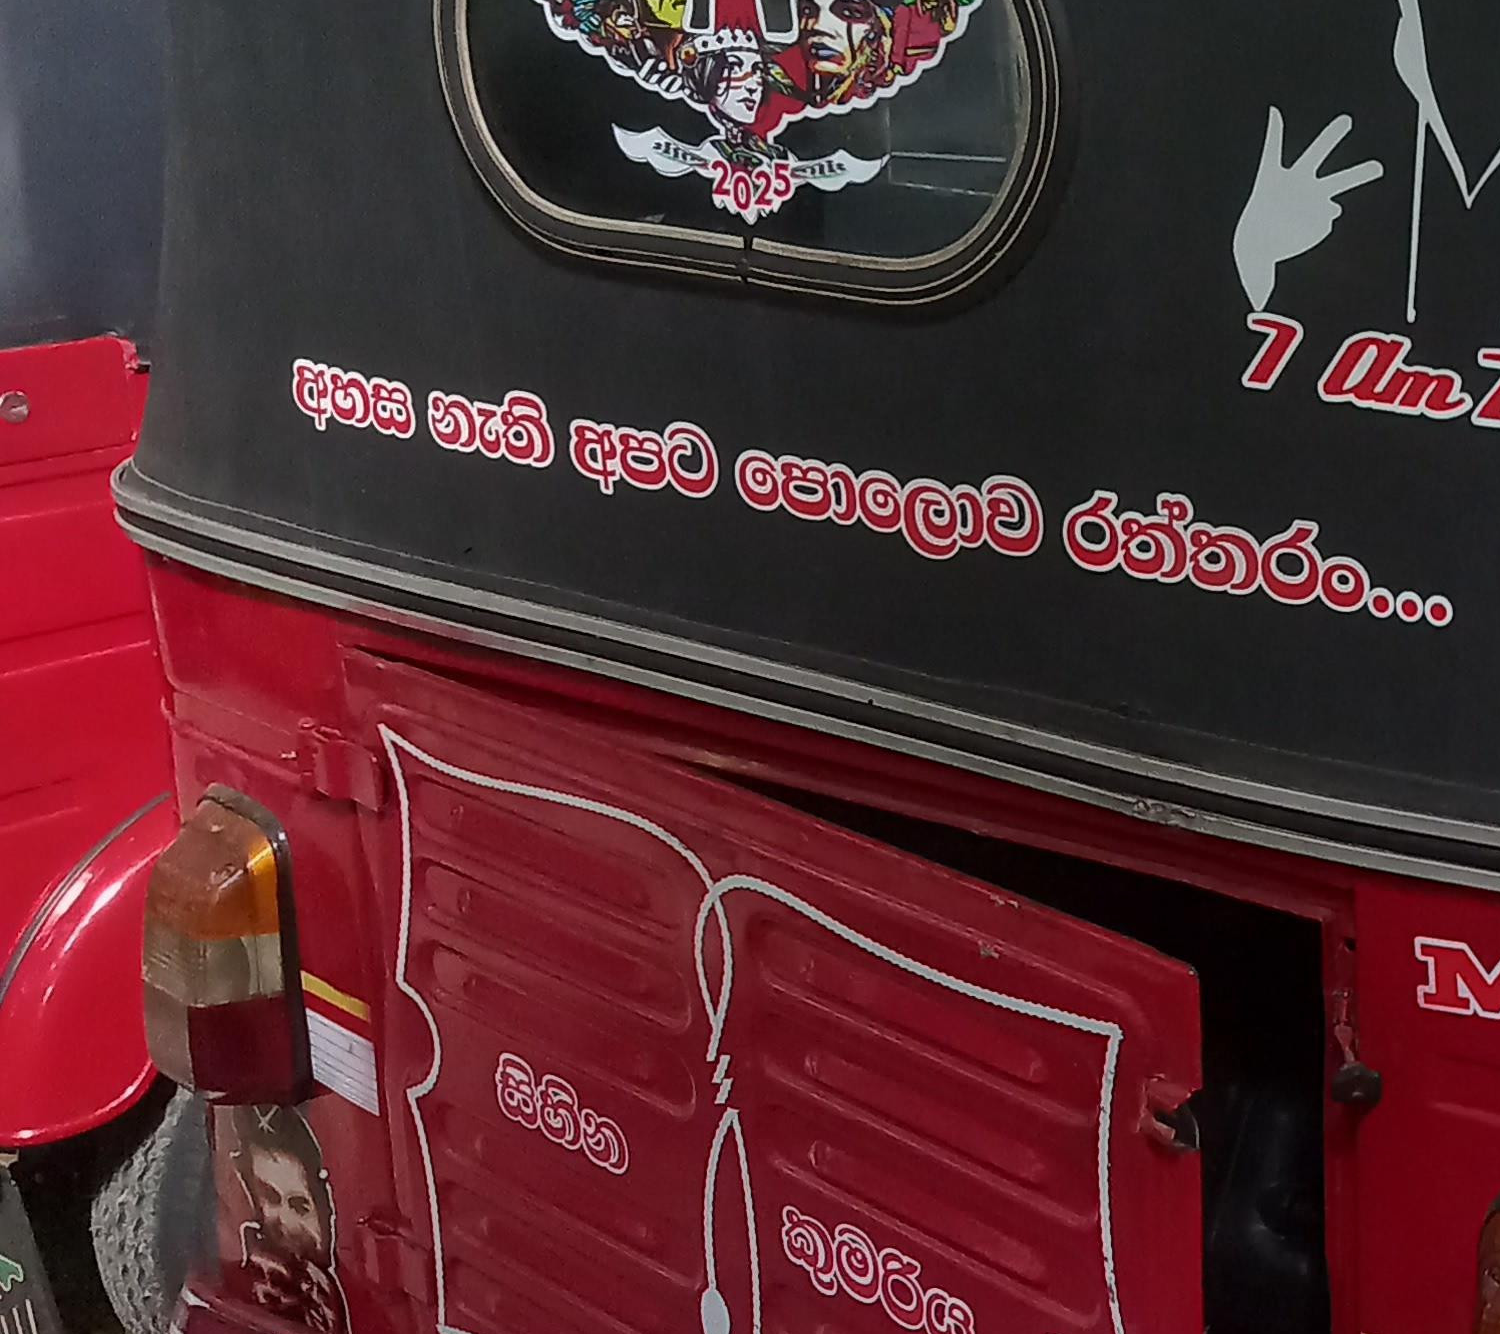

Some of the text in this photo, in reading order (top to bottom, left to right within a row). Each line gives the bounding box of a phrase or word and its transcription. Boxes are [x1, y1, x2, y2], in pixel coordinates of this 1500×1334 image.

[710, 159, 792, 212] 2025
[1318, 331, 1473, 418] Am
[293, 359, 415, 438] අහස
[570, 418, 718, 497] අපට
